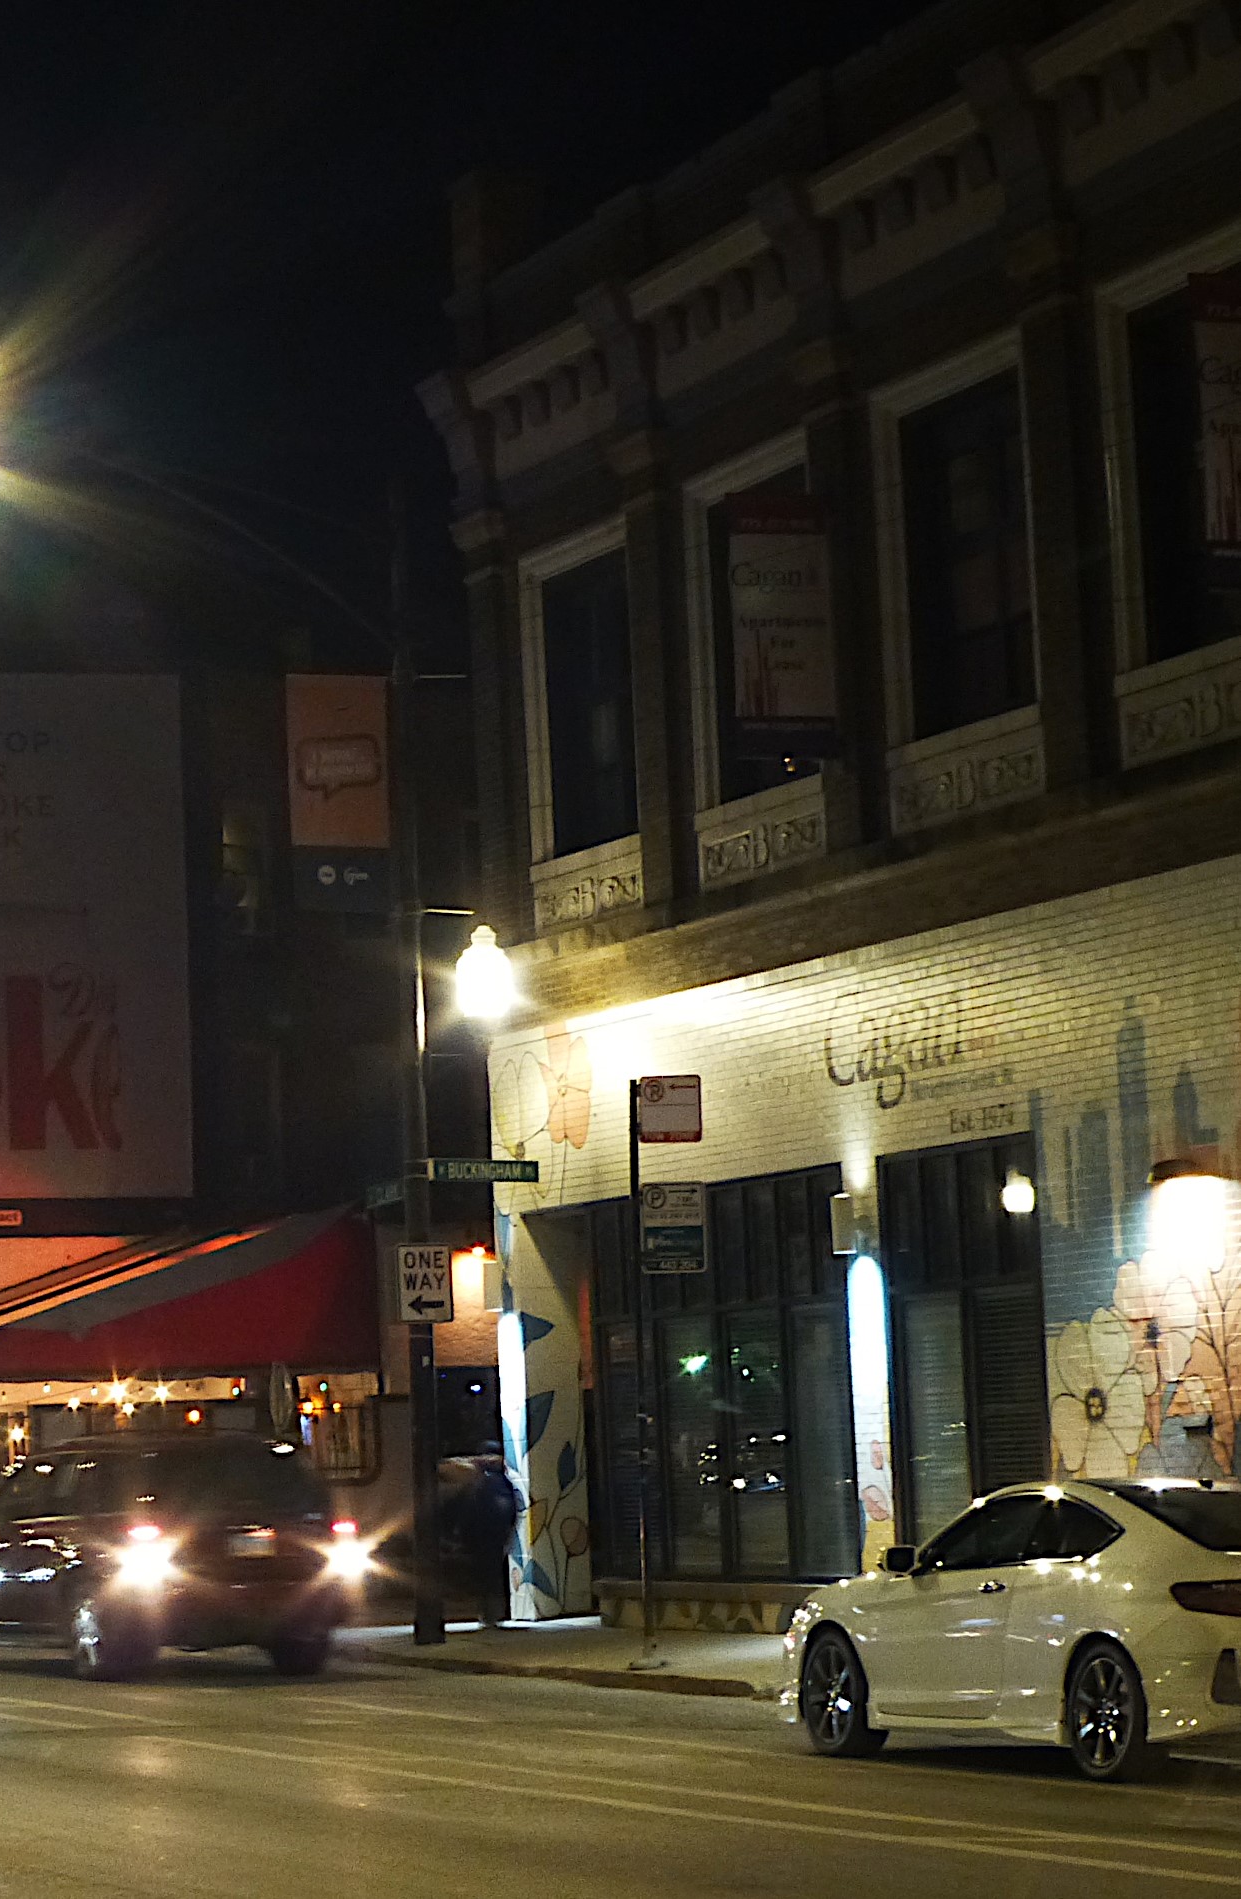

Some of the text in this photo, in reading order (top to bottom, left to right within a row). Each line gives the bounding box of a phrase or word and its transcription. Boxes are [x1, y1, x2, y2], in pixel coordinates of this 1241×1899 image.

[731, 561, 802, 594] Cagan
[447, 1161, 522, 1180] BUCKINGHAM
[404, 1251, 445, 1270] ONE
[404, 1272, 446, 1291] WAY
